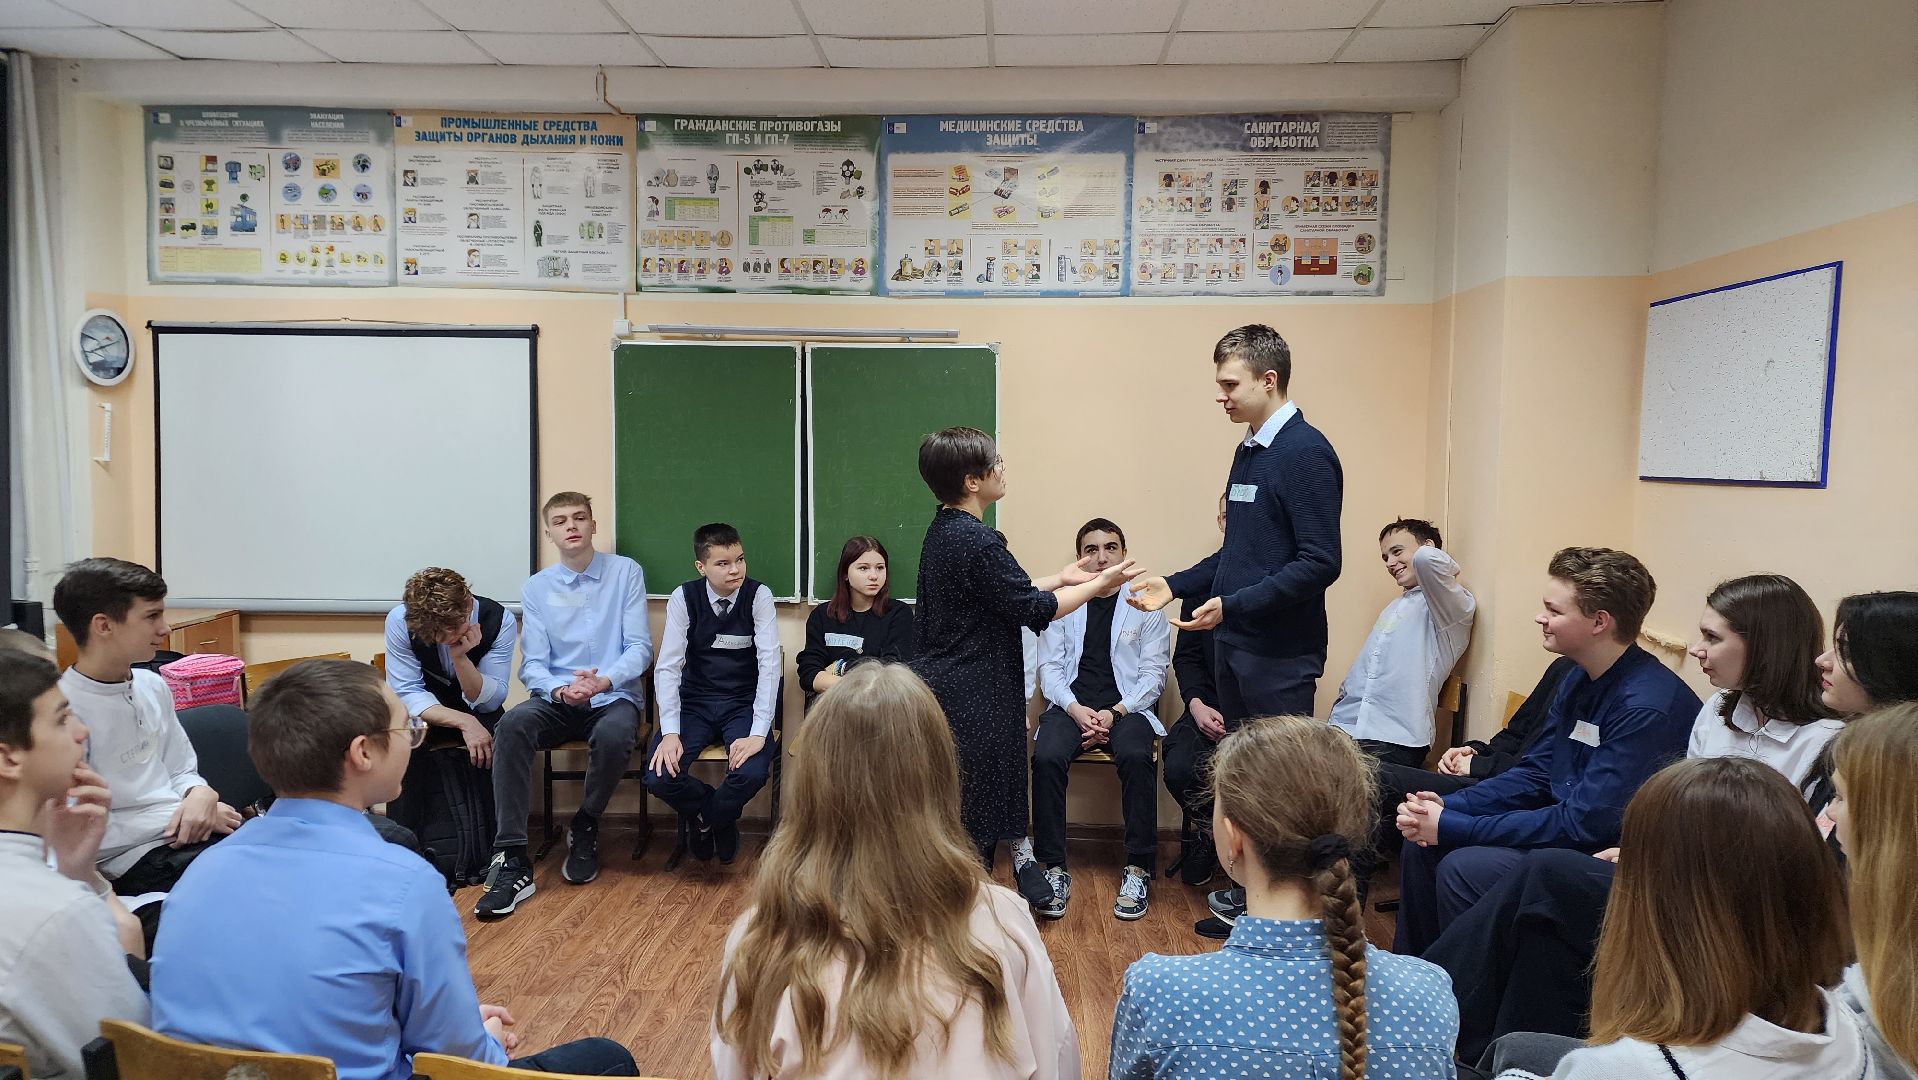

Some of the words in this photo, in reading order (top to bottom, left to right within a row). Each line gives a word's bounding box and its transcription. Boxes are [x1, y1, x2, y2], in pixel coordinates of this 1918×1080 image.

[440, 116, 539, 131] ПРОМЫШЛЕННЫЕ
[543, 120, 598, 132] СРЕДСТВА
[674, 118, 757, 132] ГРАЖДАНСКИЕ
[759, 120, 841, 132] ПРОТИВОГАЗЫ
[939, 119, 1021, 134] МЕДИЦИНСКИЕ
[1025, 119, 1084, 134] СРЕДСТВА
[1244, 121, 1321, 134] САНИТАРНАЯ
[415, 131, 463, 143] ЗАЩИТЫ
[466, 131, 517, 144] ОРГАНОВ
[521, 133, 576, 146] ДЫХАНИЯ
[579, 134, 587, 146] И
[590, 134, 624, 147] КОЖИ
[725, 133, 751, 145] ГП-5
[753, 133, 762, 145] И
[764, 133, 790, 145] ГП-7
[986, 133, 1038, 147] ЗАЩИТЫ
[1250, 135, 1320, 148] ОБРАБОТКА
